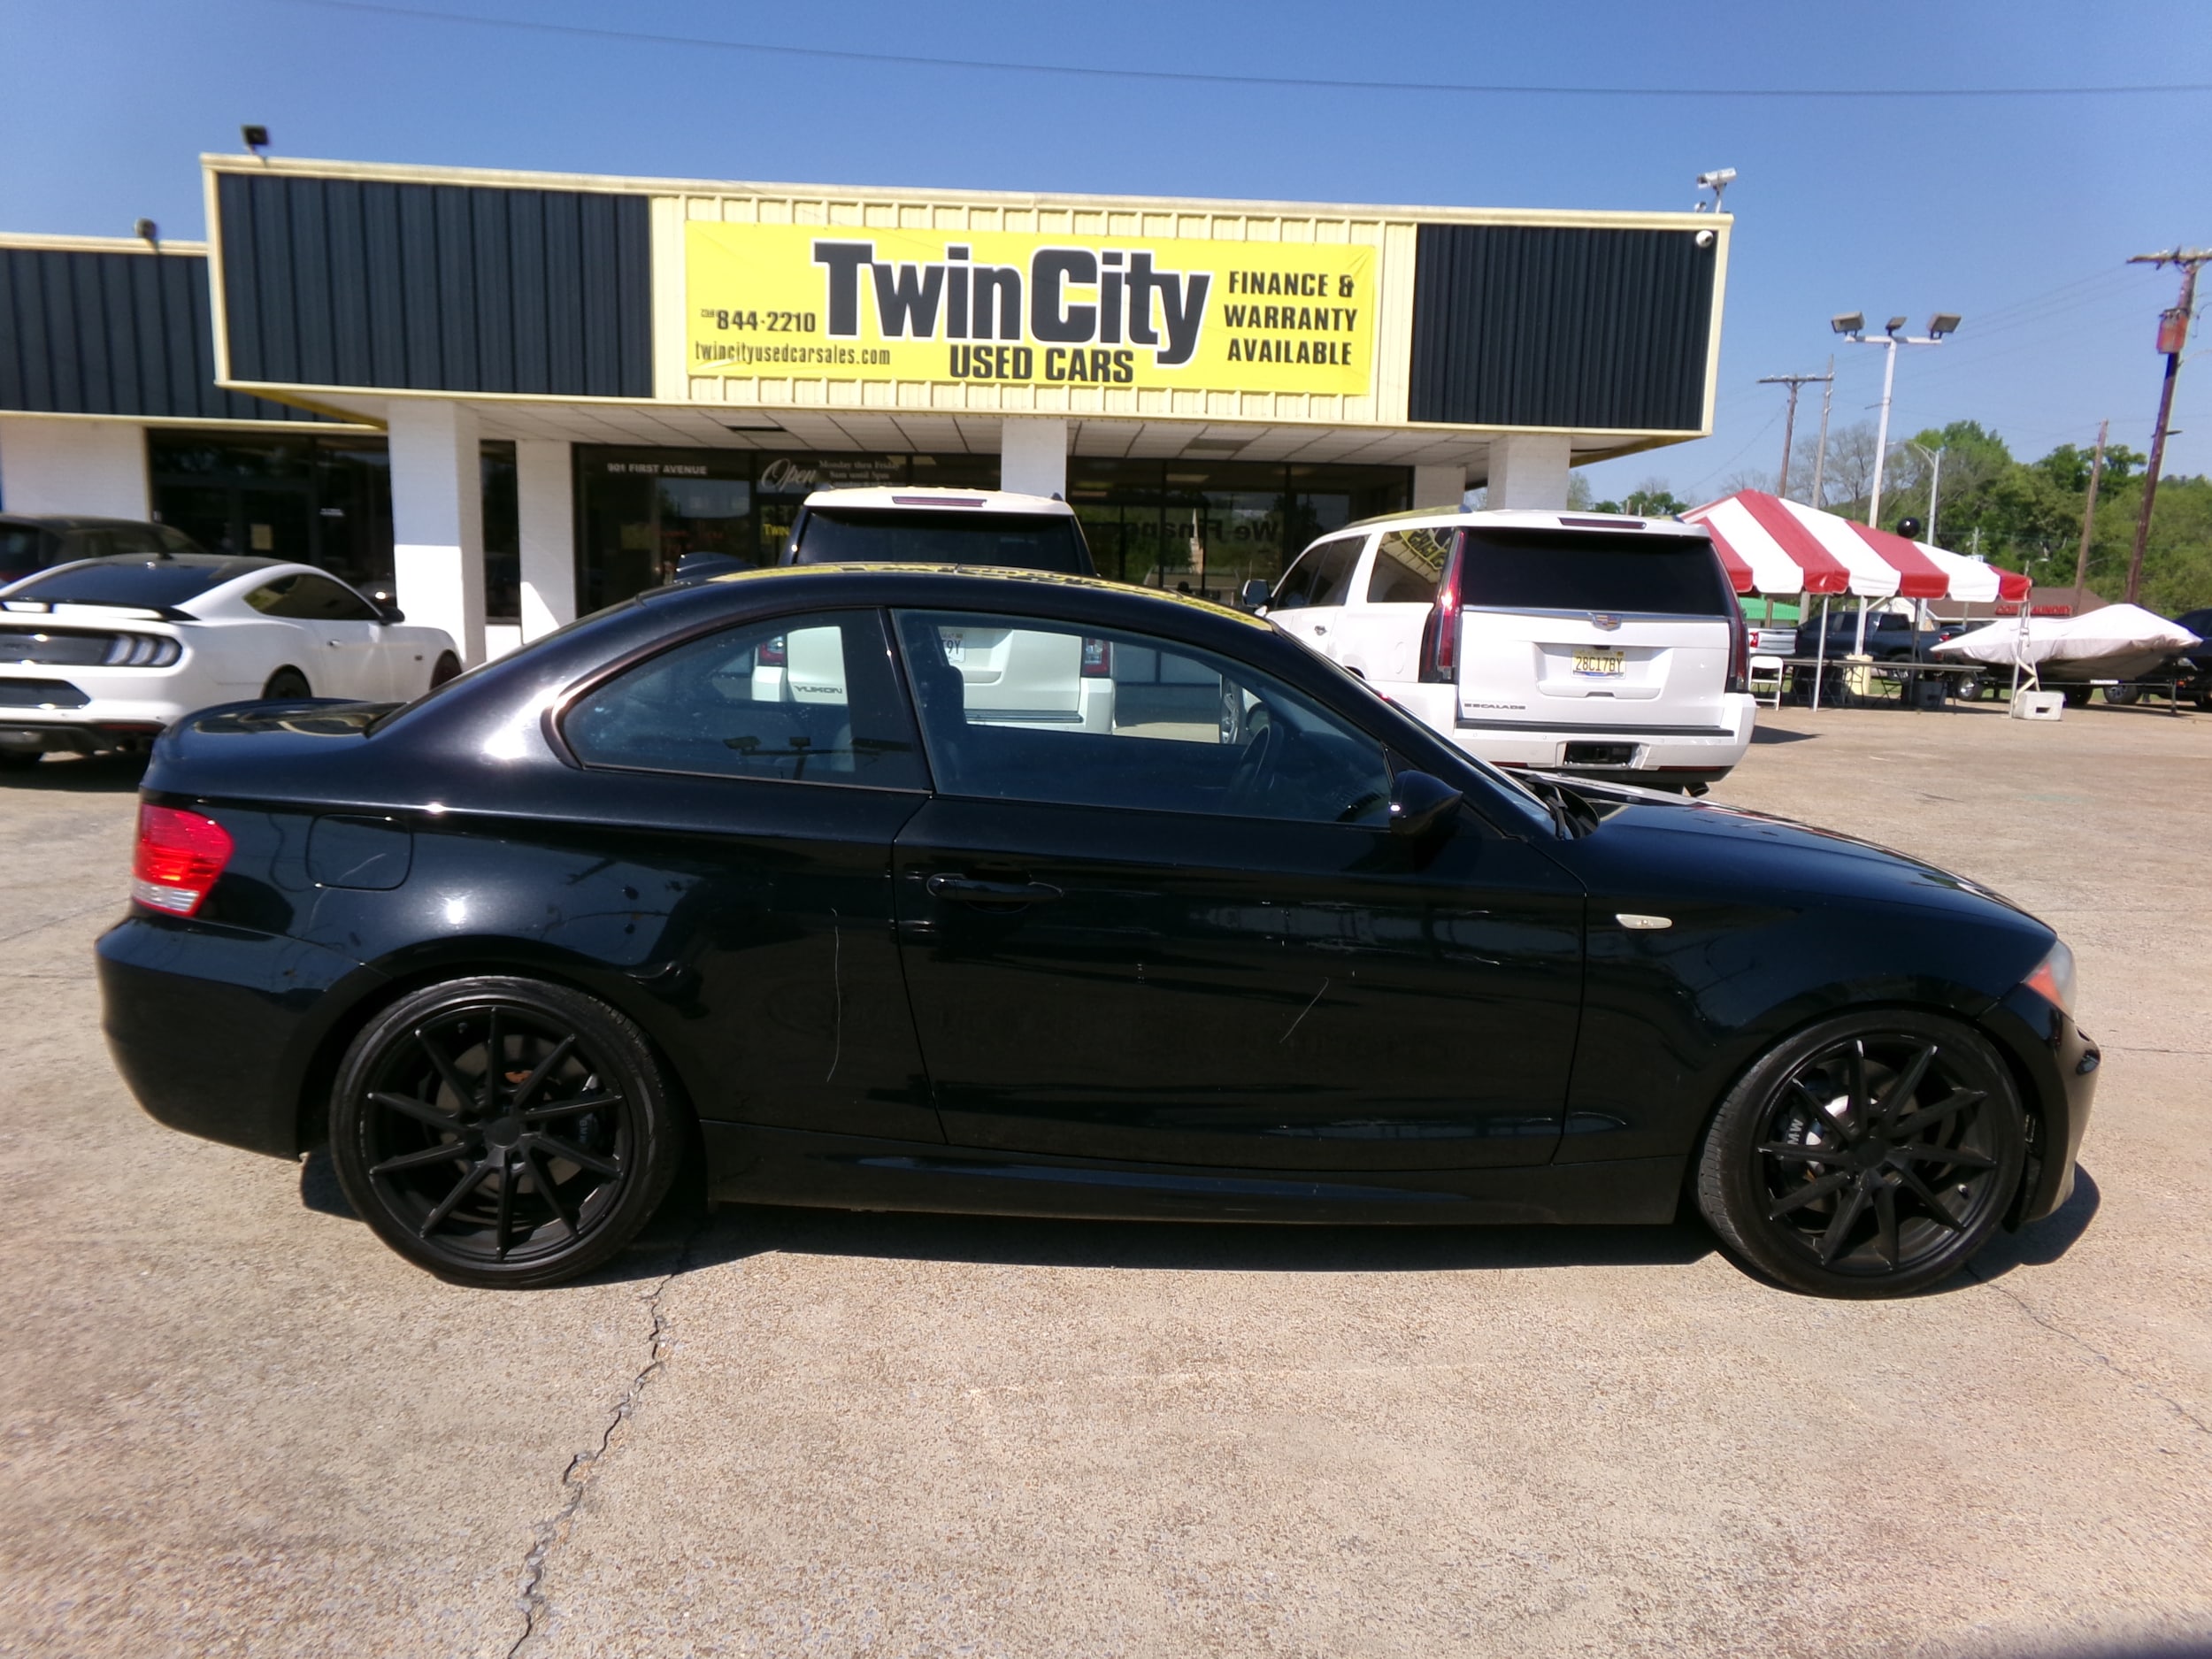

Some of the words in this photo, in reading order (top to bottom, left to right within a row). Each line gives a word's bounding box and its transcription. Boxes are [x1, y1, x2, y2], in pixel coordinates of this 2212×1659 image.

[1228, 271, 1328, 297] FINANCE
[1339, 275, 1355, 298] &
[1224, 303, 1358, 332] WARRANTY
[695, 341, 890, 365] twincityusedcarsales.com
[949, 344, 1032, 380] USED
[1044, 347, 1133, 383] CARS
[1227, 338, 1352, 365] AVAILABLE
[628, 463, 660, 474] FIRST
[662, 465, 708, 475] AVENUE
[761, 457, 817, 492] Open
[819, 460, 852, 471] Monday
[794, 685, 843, 694] YUKON
